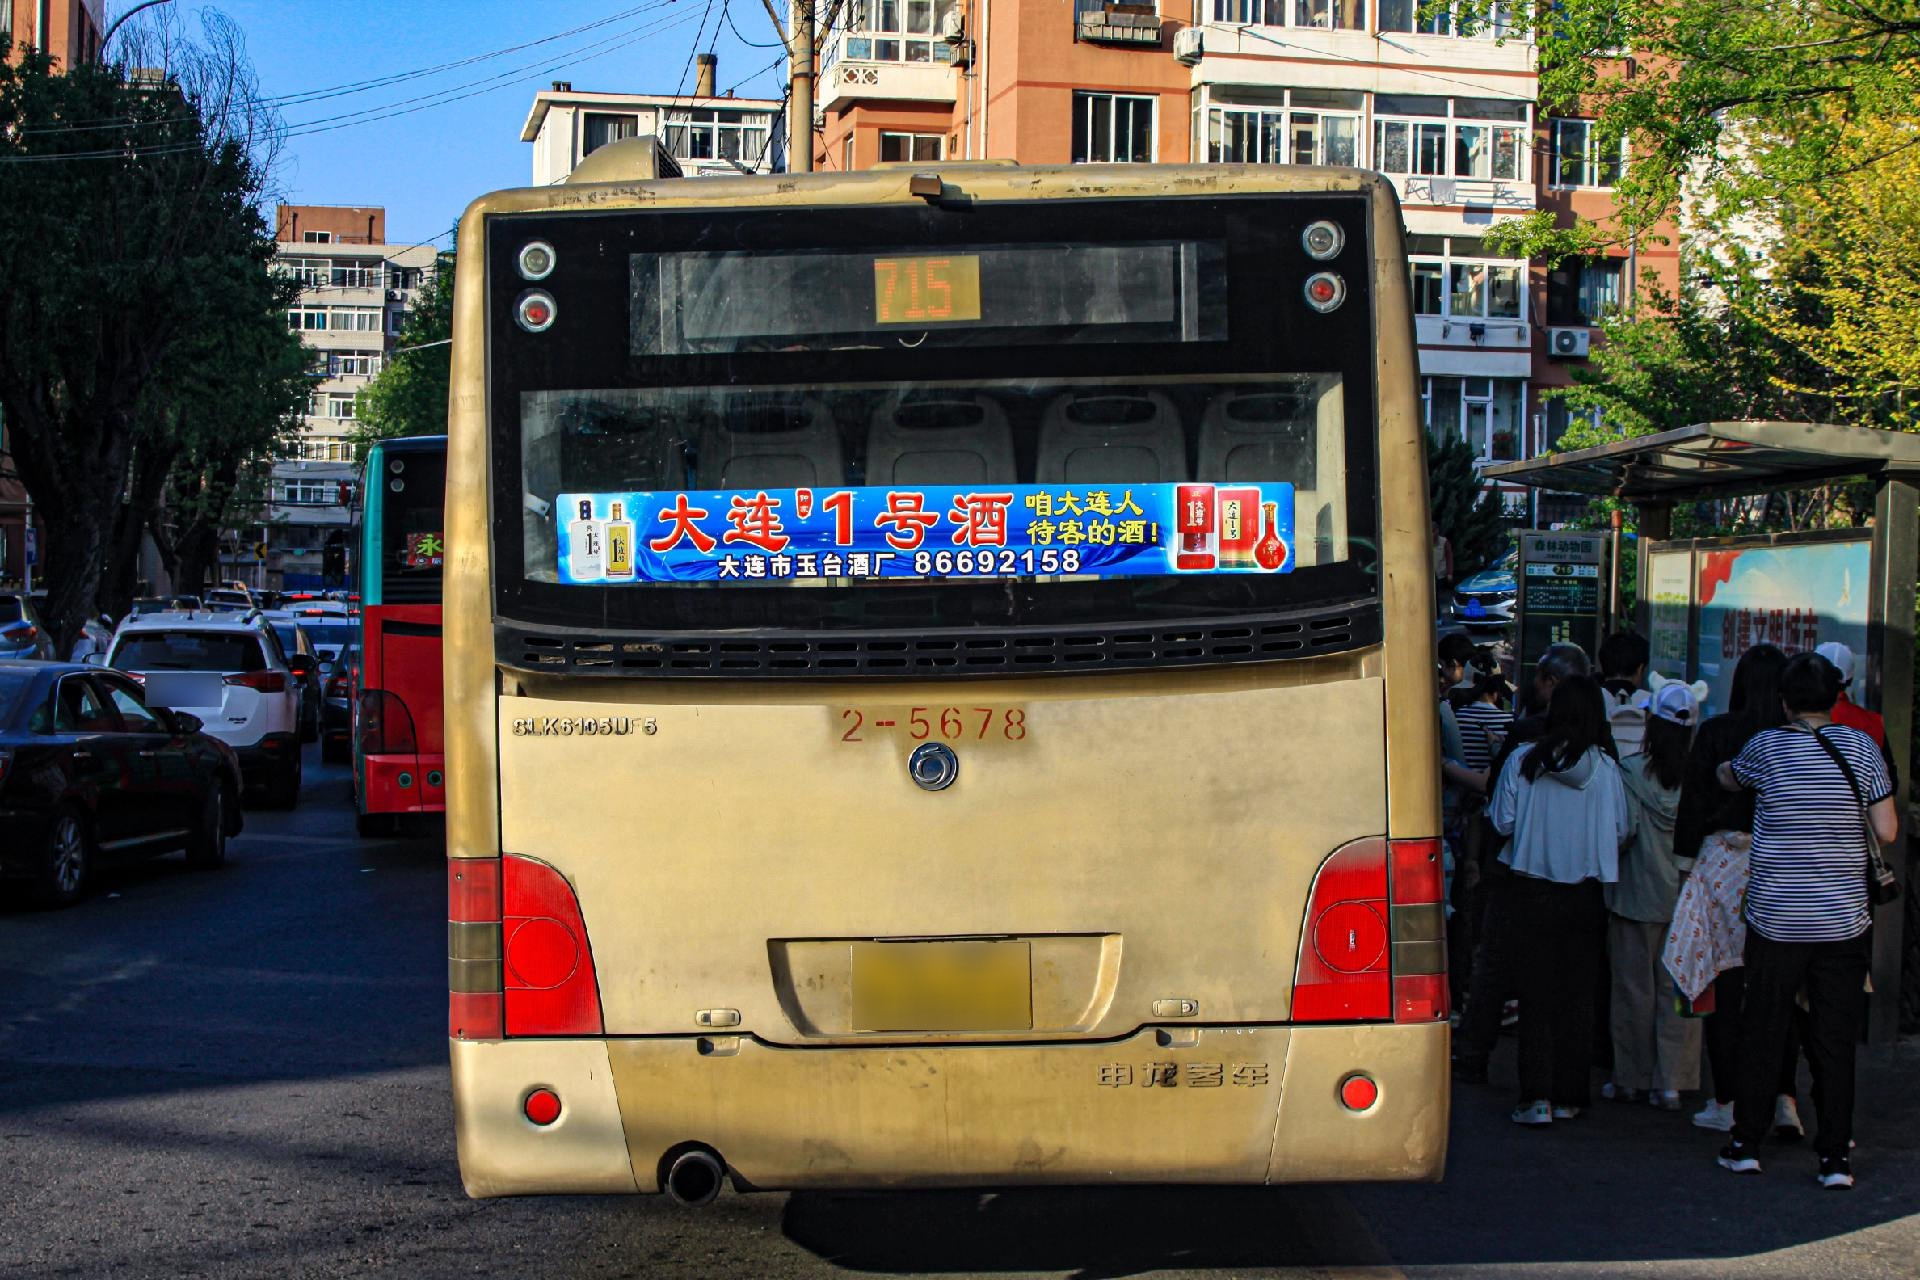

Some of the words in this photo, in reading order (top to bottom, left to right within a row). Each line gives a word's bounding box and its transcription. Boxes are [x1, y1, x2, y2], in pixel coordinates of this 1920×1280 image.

[874, 260, 951, 320] 715
[1025, 490, 1144, 516] 咱大连人
[1026, 518, 1158, 546] 待客的酒!
[1535, 540, 1593, 553] 森林动物园
[718, 551, 895, 578] 大连市玉台酒厂
[914, 549, 1081, 575] 86692158
[841, 707, 1026, 742] 2-5678
[1098, 1063, 1269, 1088] 申龙客车
